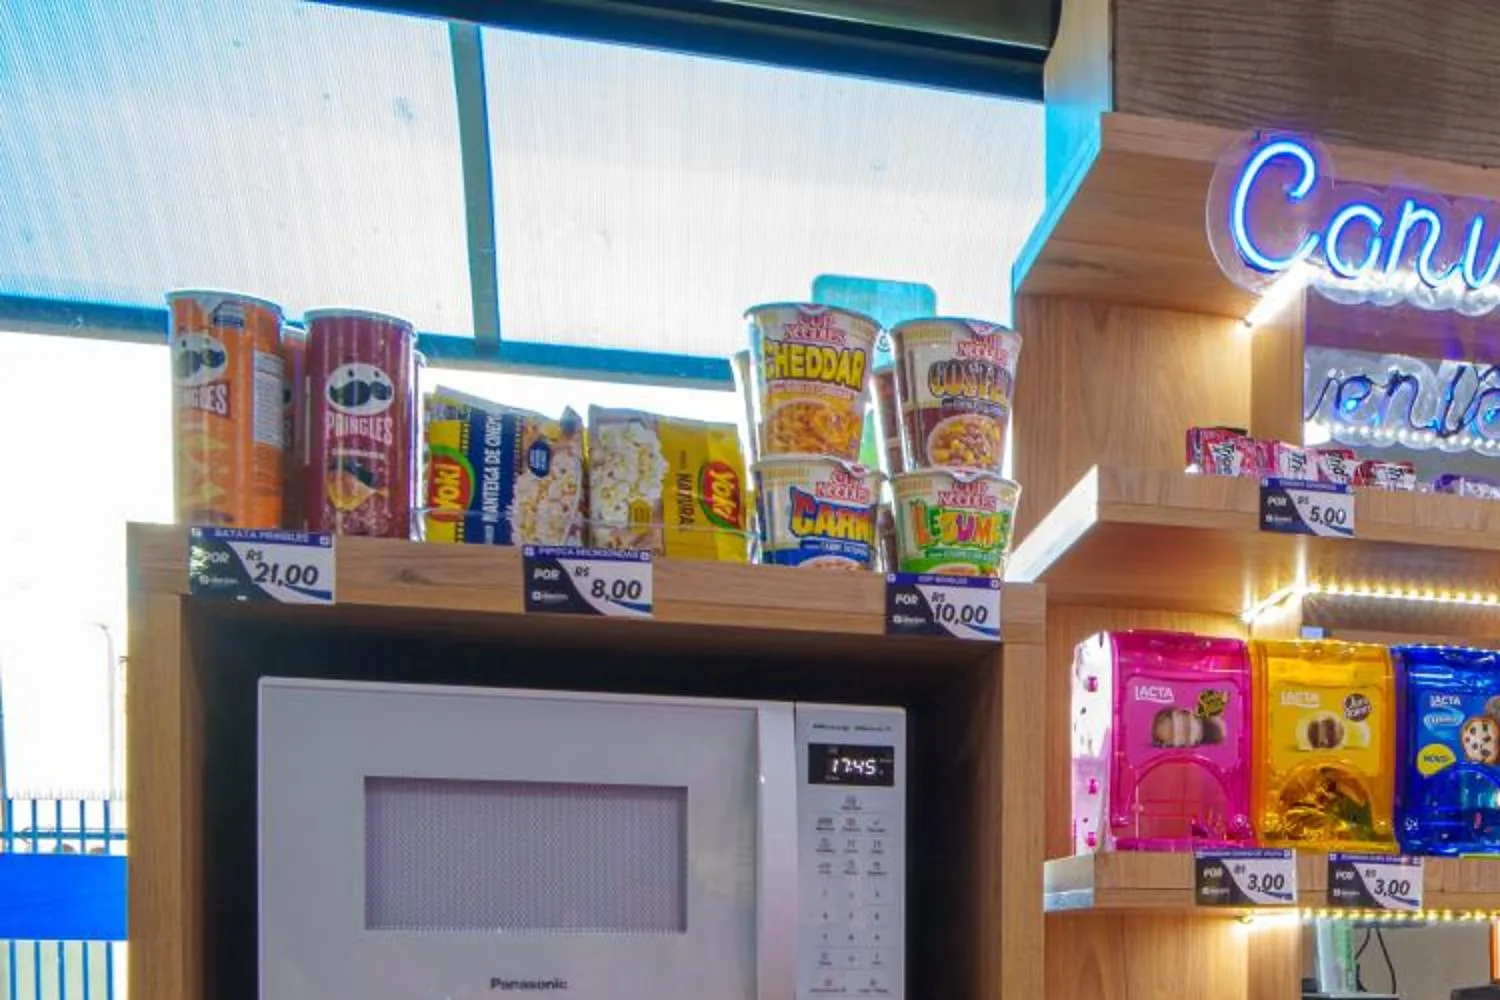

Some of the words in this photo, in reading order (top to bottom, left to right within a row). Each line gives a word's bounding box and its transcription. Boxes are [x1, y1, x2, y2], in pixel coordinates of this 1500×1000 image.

[764, 339, 866, 391] CHEDDAR
[325, 409, 394, 446] PRINGLES
[483, 448, 501, 464] DE
[480, 465, 501, 522] MANTEIGA
[1267, 496, 1286, 507] POR
[1309, 506, 1347, 526] 5,00
[213, 528, 257, 539] BATATA
[253, 562, 319, 587] 21,00
[533, 567, 561, 580] POR
[591, 578, 643, 601] 8,00
[895, 593, 919, 605] POR
[934, 603, 988, 624] 10,00
[1135, 685, 1175, 702] LACTA
[1203, 867, 1223, 878] POR
[1335, 870, 1355, 881] POR
[1247, 873, 1285, 893] 3,00
[1373, 879, 1411, 897] 3,00
[490, 977, 568, 990] Panasonic
